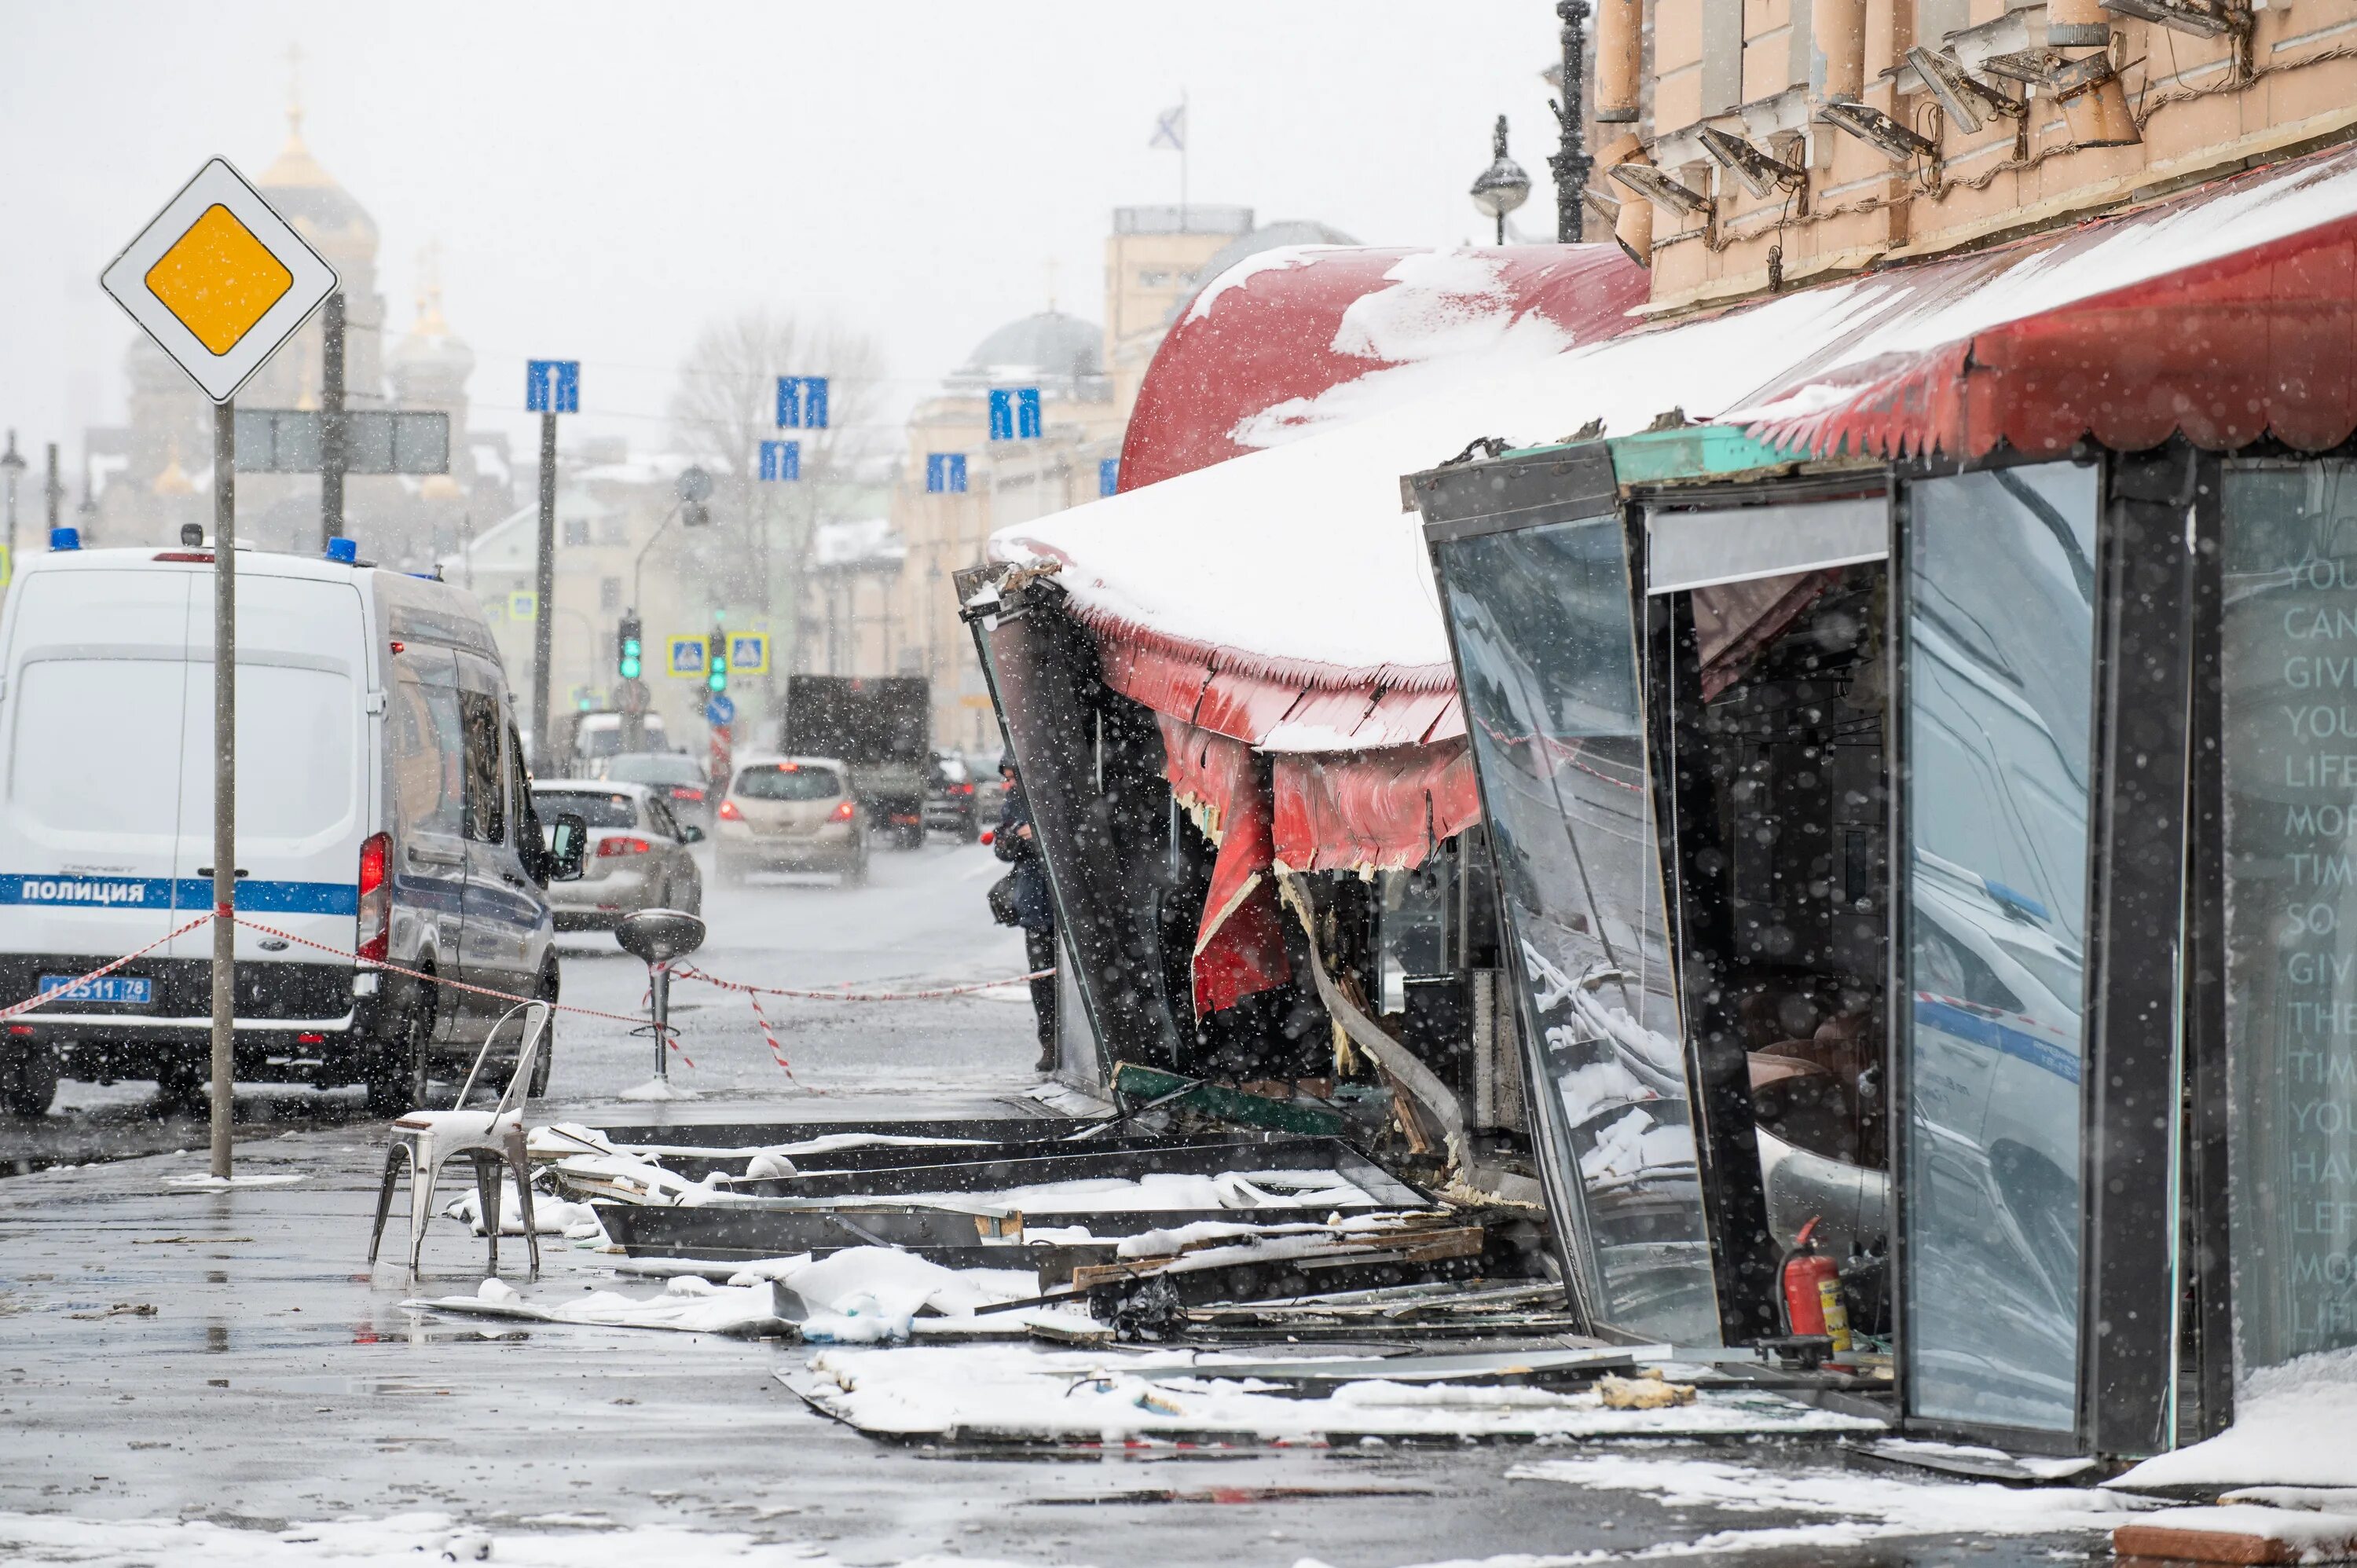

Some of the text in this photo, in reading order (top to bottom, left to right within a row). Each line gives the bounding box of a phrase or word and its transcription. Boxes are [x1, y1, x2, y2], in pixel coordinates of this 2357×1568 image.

[2284, 607, 2357, 639] CAN
[2285, 656, 2357, 688] GIV
[2286, 754, 2357, 786] LIFE
[22, 881, 145, 905] ПОЛИЦИЯ
[2287, 903, 2335, 935] SO
[2288, 952, 2354, 984] GIV
[125, 980, 144, 995] 78
[2288, 1002, 2357, 1034] THE
[2289, 1051, 2357, 1084] TIM
[2292, 1251, 2357, 1284] MO
